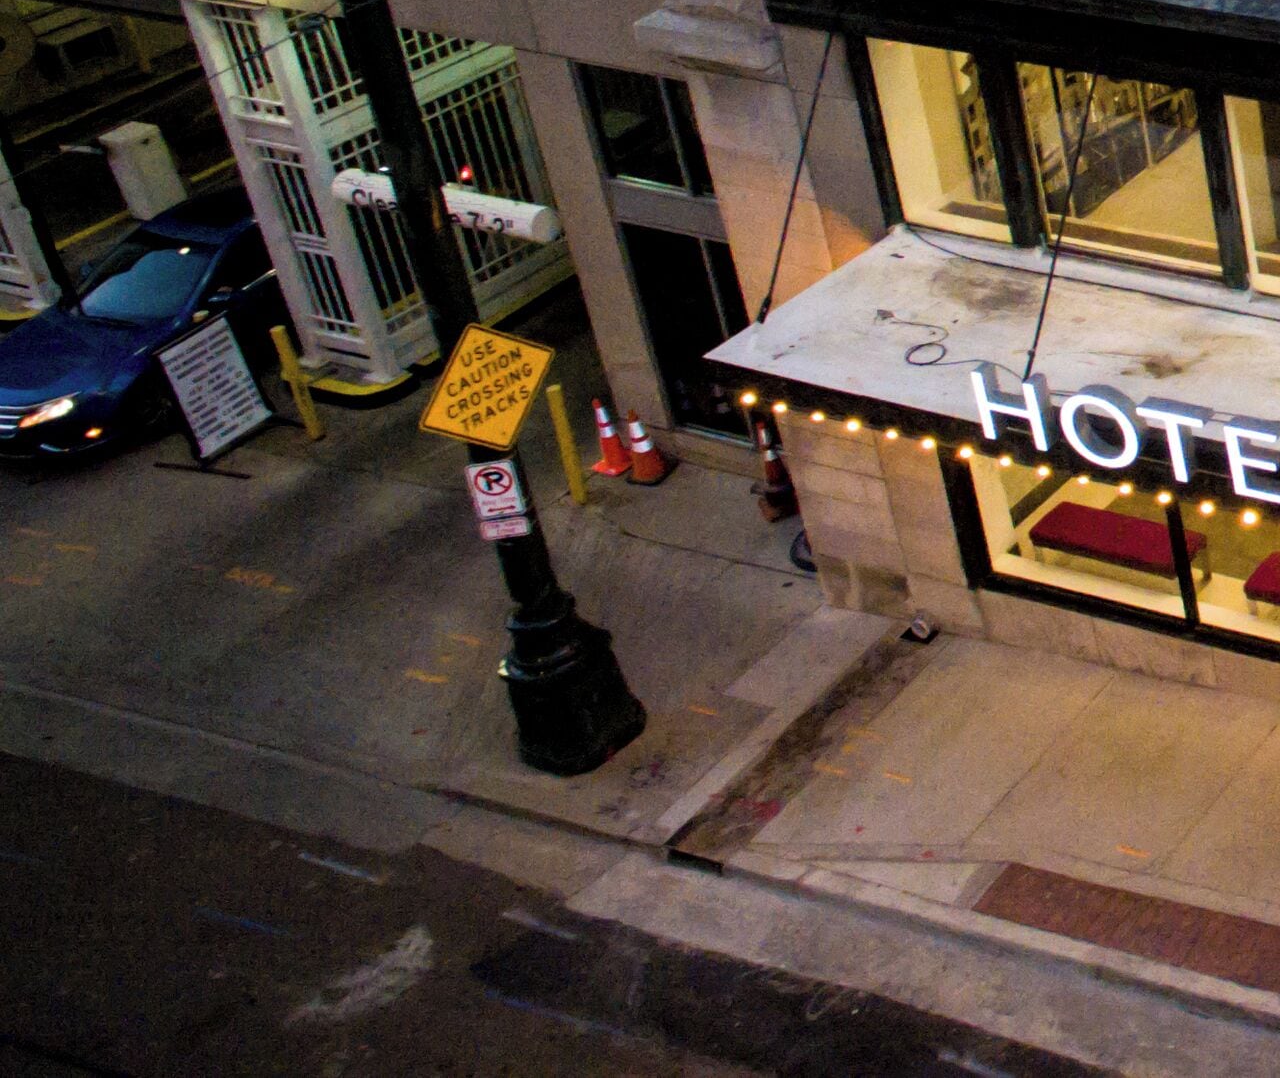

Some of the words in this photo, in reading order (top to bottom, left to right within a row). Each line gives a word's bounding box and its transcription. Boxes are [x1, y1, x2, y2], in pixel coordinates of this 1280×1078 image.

[446, 347, 523, 398] CAUTION
[461, 340, 497, 368] USE
[447, 363, 533, 419] CROSSING
[460, 385, 530, 432] TRACKS
